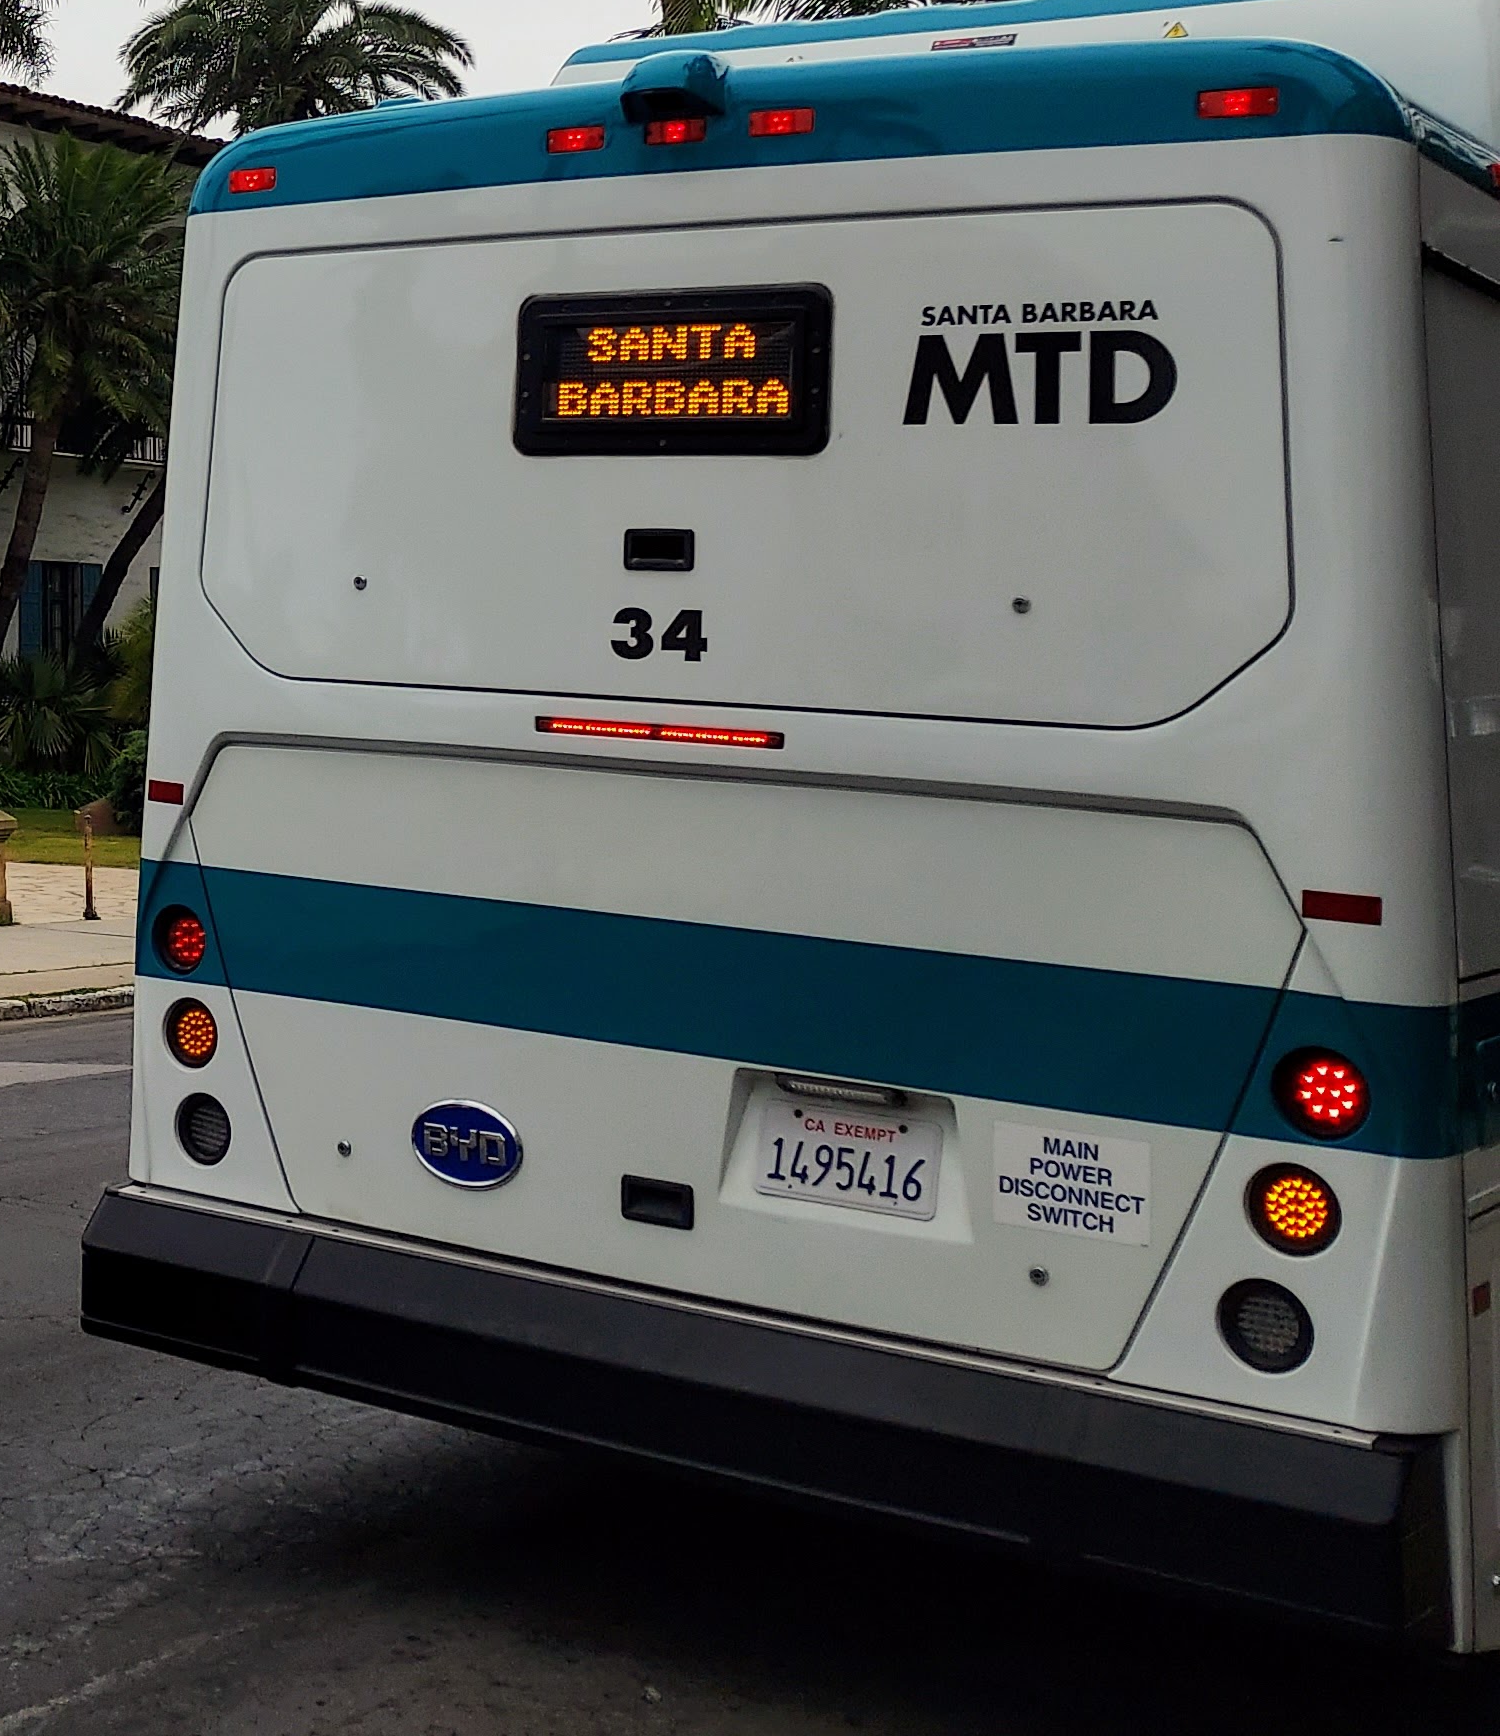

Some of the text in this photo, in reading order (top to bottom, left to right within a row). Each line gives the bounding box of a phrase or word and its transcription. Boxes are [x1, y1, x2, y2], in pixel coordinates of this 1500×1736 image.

[921, 300, 1159, 327] SANTA BARBARA
[587, 322, 757, 363] SANTA
[557, 377, 790, 416] BARBARA
[902, 329, 1178, 426] MTD
[610, 606, 708, 662] 34
[423, 1121, 507, 1167] BYD
[804, 1118, 897, 1143] CA EXEMPT
[1043, 1136, 1099, 1161] MAIN
[766, 1136, 926, 1202] 1495416
[1030, 1157, 1113, 1187] POWER
[999, 1175, 1146, 1215] DISCONNECT
[1027, 1202, 1114, 1234] SWITCH
